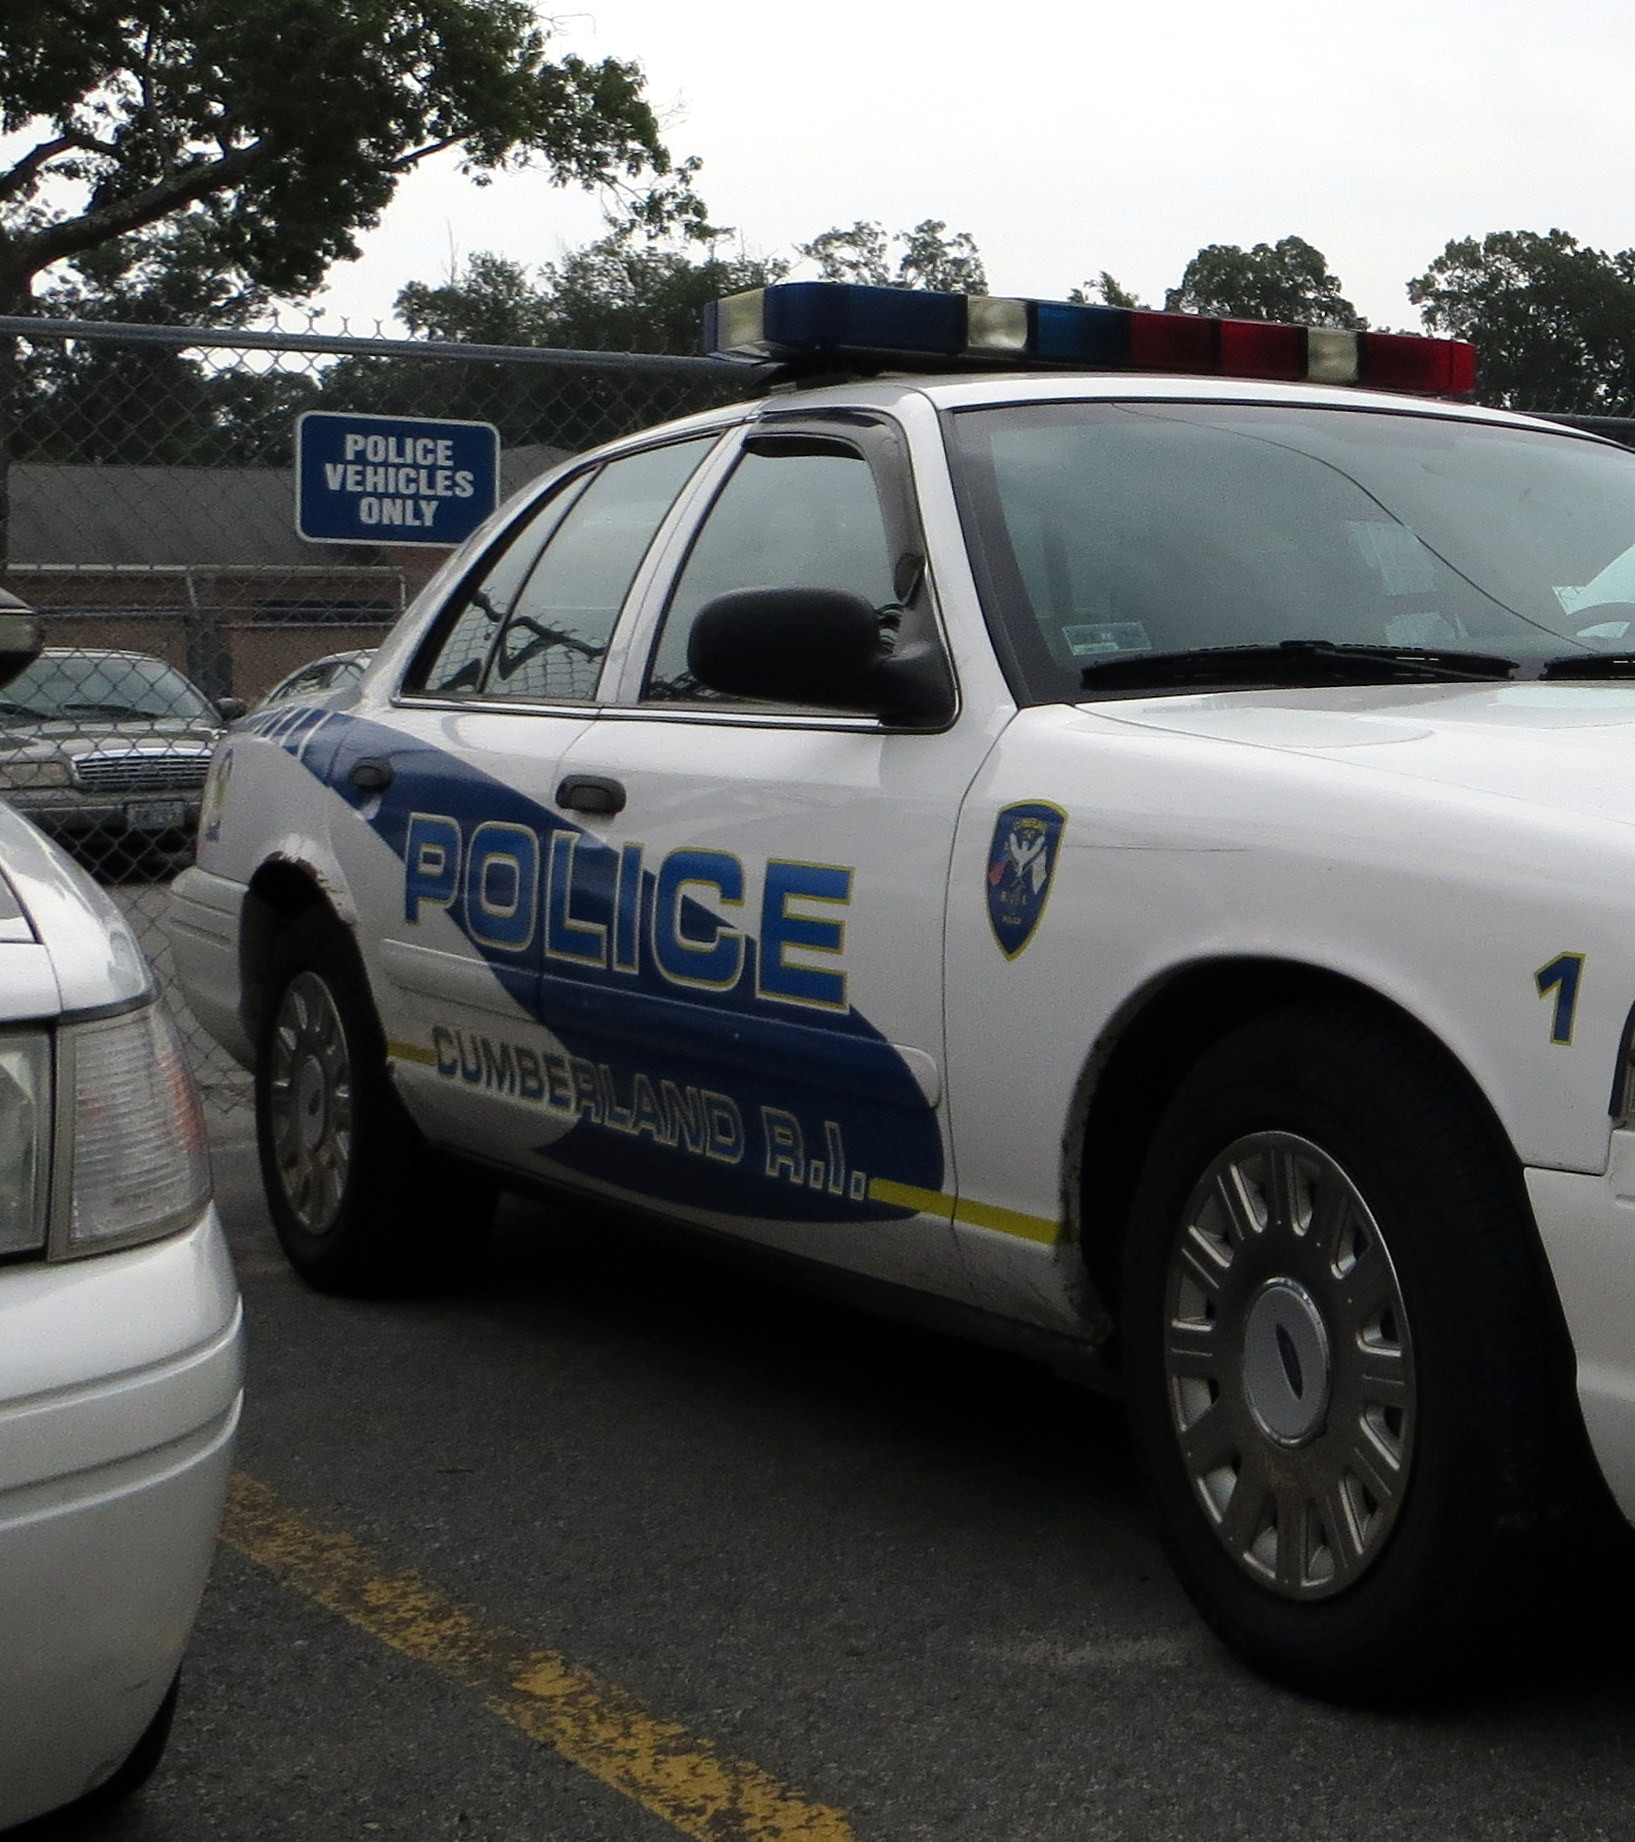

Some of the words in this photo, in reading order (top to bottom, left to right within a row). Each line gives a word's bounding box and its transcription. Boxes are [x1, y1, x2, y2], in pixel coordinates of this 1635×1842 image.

[325, 463, 475, 498] VEHICLES
[345, 434, 453, 466] POLICE
[361, 497, 440, 527] ONLY
[404, 812, 856, 1015] POLICE
[1534, 951, 1586, 1046] 1
[432, 1024, 744, 1164] CUMBERLAND
[761, 1106, 867, 1200] R.I.
